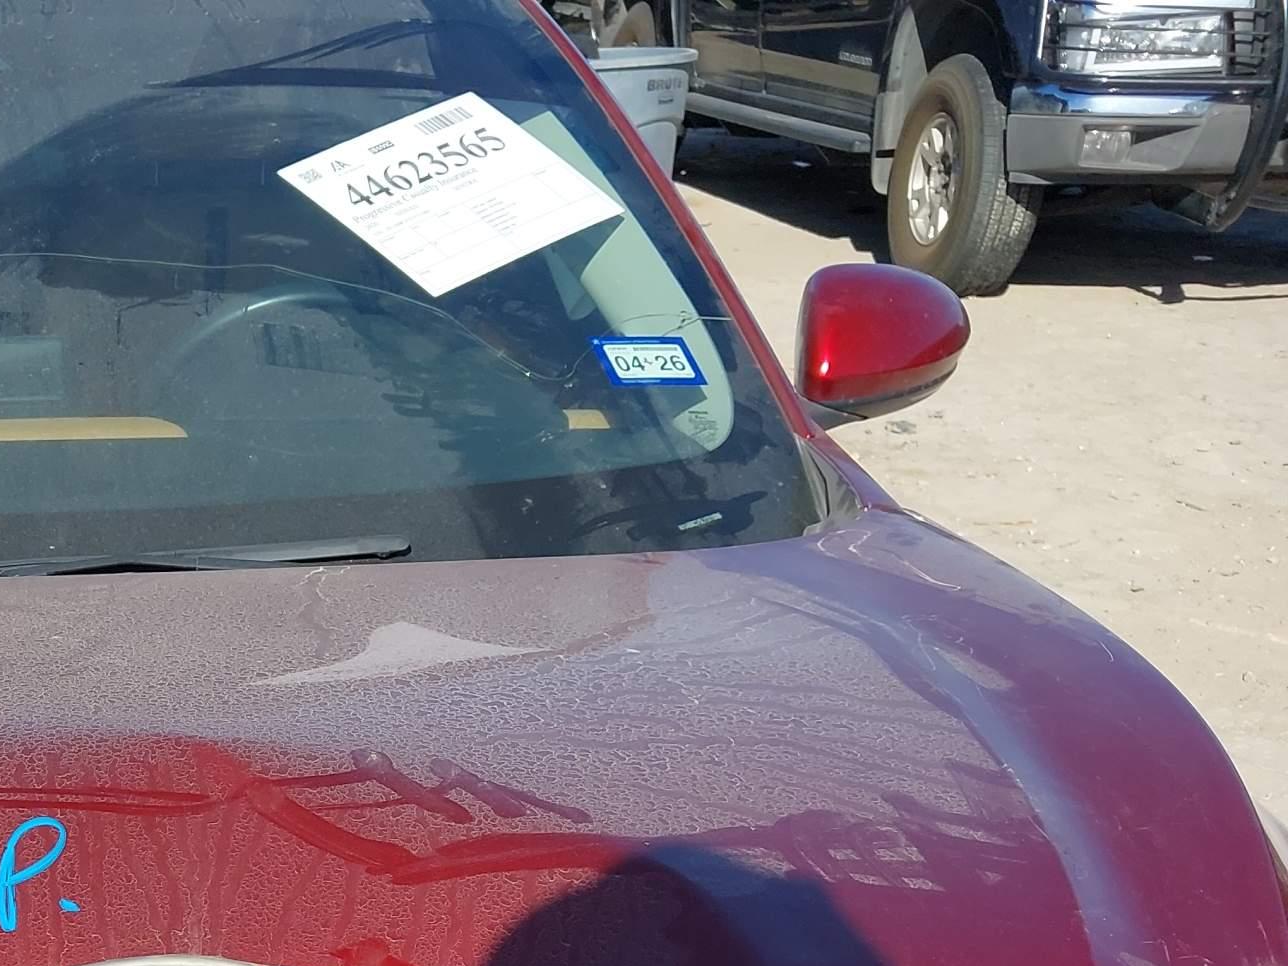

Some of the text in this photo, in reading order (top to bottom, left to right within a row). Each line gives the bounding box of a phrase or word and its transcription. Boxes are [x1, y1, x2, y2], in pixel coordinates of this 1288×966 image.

[346, 127, 506, 206] 44623565
[614, 355, 686, 372] 04 26
